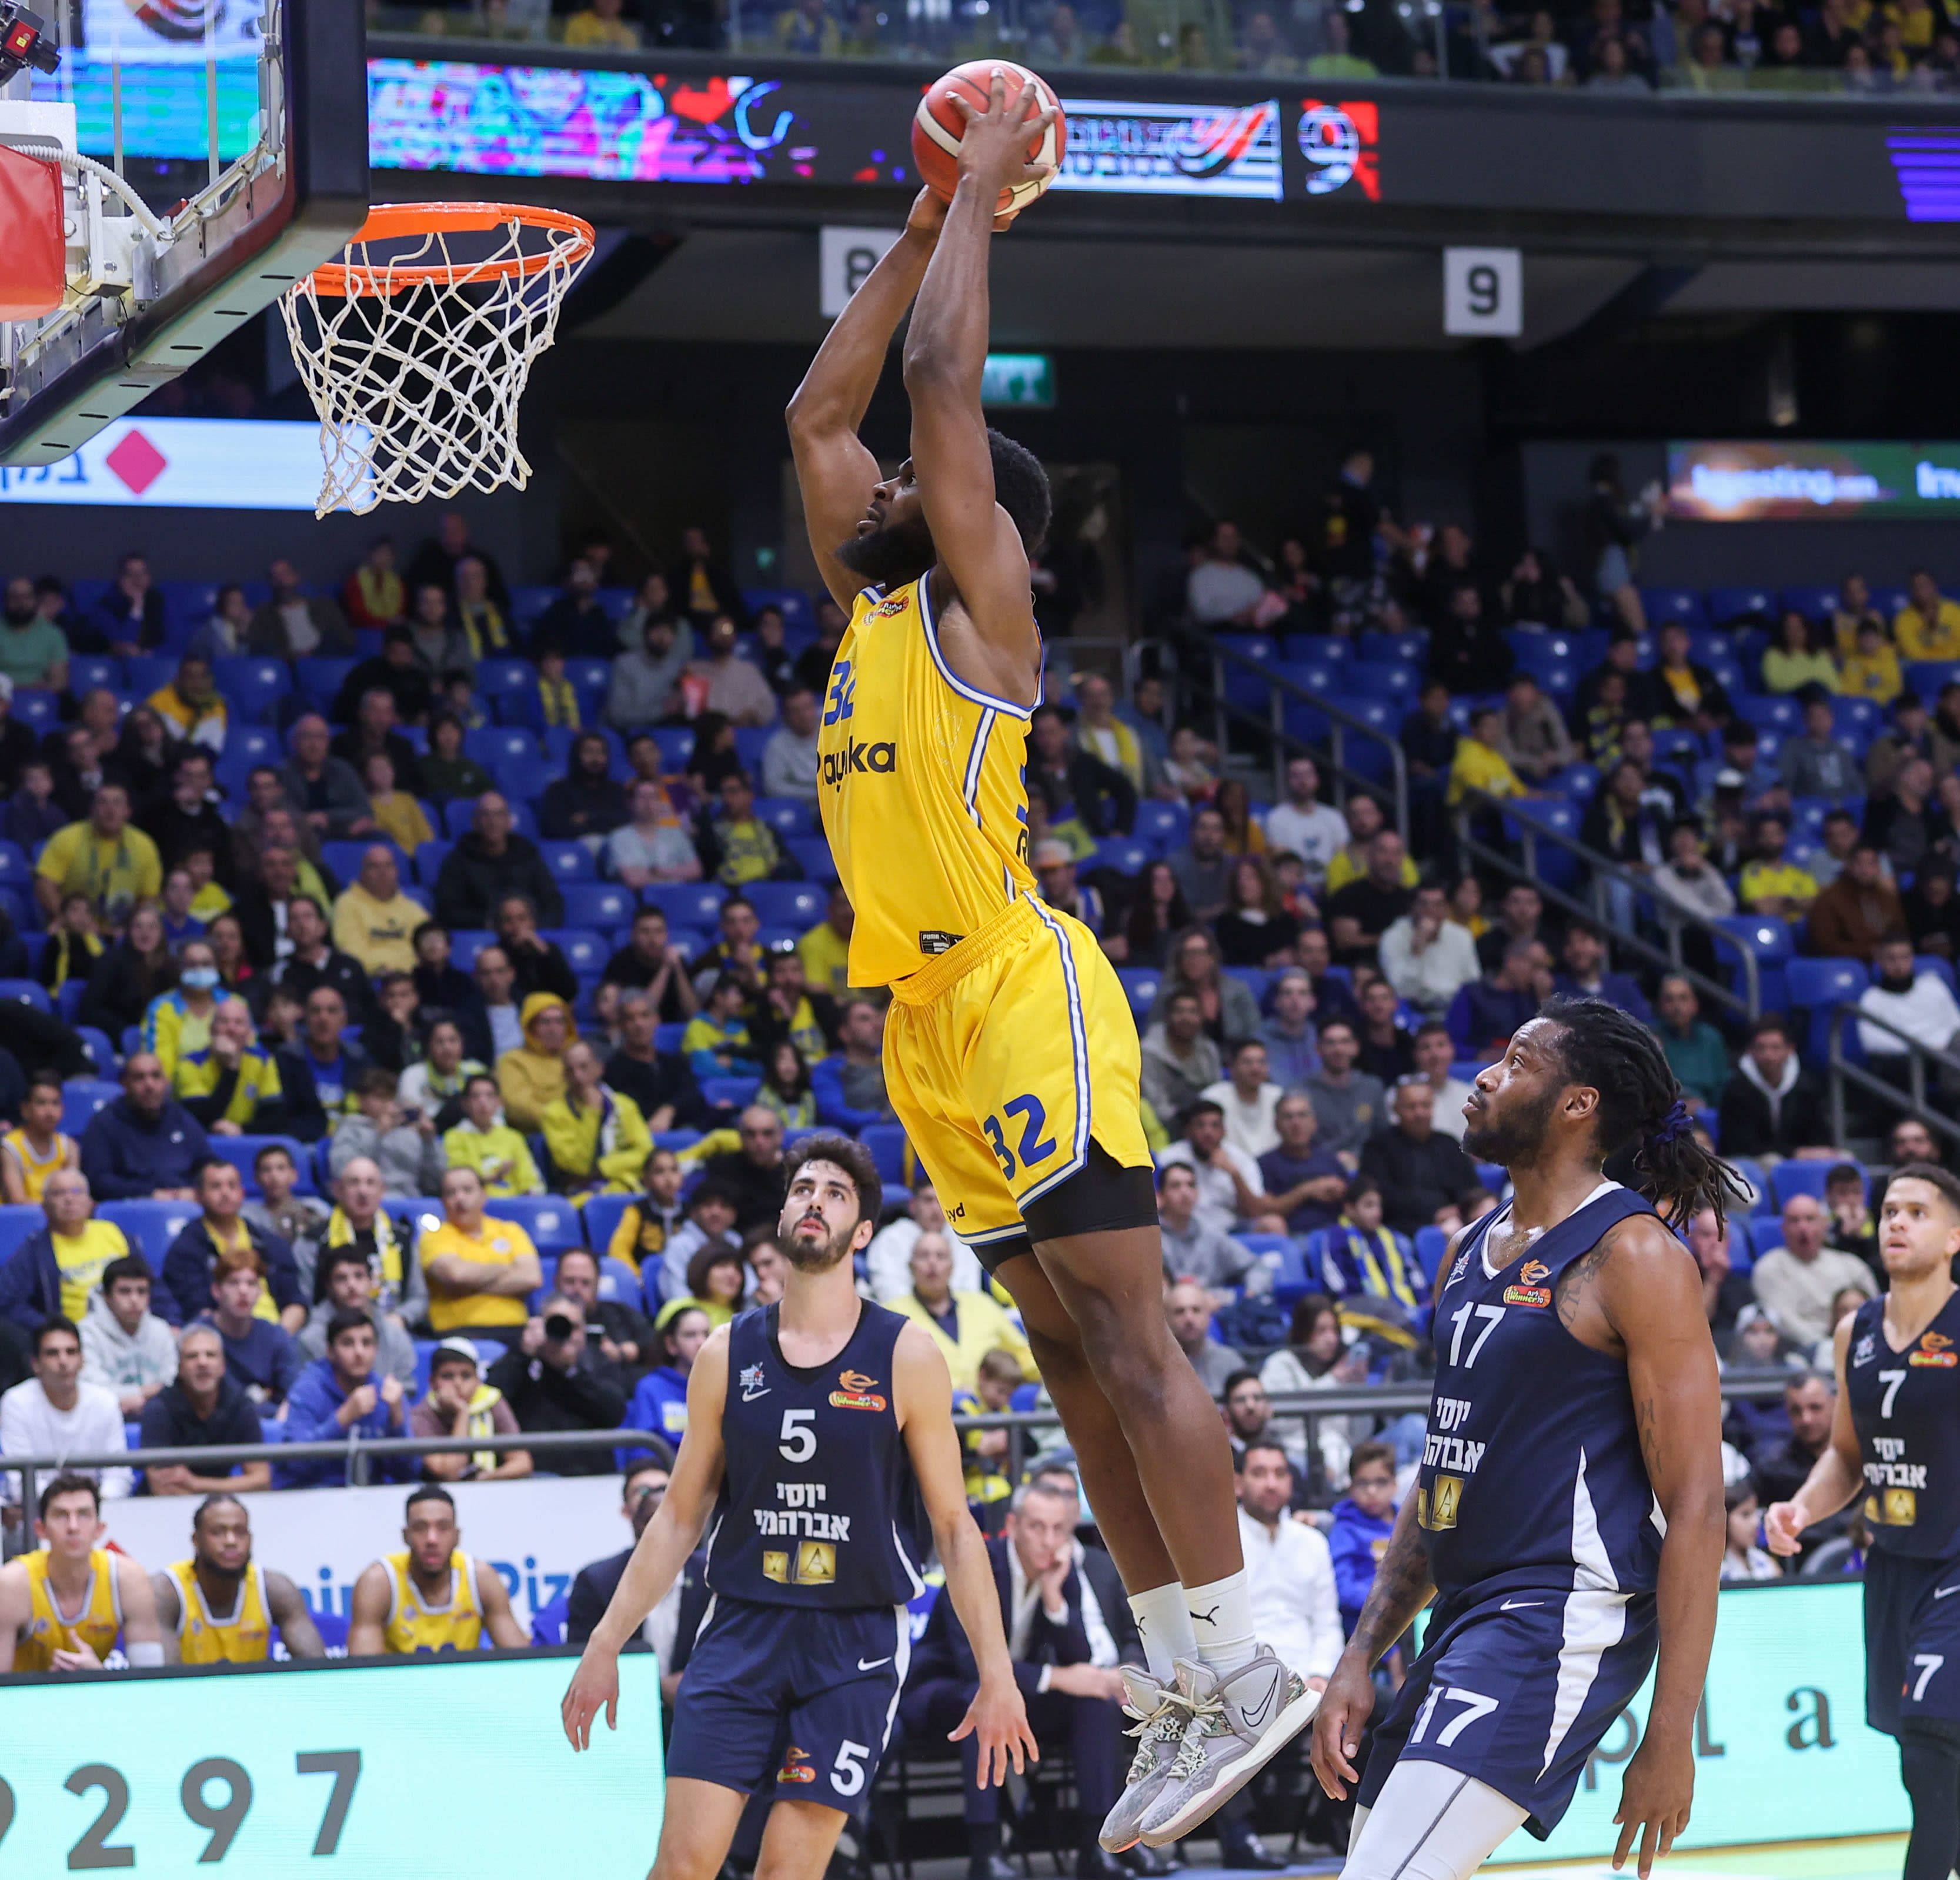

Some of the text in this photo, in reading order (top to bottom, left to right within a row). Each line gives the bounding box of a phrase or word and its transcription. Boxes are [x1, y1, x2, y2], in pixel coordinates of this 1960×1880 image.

[1468, 265, 1499, 316] 9
[984, 1094, 1057, 1180] 32
[946, 1202, 966, 1222] yd
[1510, 1291, 1537, 1303] Winner
[1448, 1301, 1506, 1369] 17
[837, 1395, 872, 1407] Winner
[1436, 1397, 1471, 1431] יוסי
[1878, 1370, 1906, 1418] 7
[779, 1409, 817, 1463] 5
[776, 1482, 826, 1508] יוסי
[1436, 1482, 1452, 1518] A
[753, 1509, 850, 1542] אברהמי
[806, 1547, 830, 1575] A
[1912, 1654, 1945, 1702] 7
[1411, 1687, 1500, 1748] 17
[830, 1739, 870, 1796] 5
[0, 1749, 361, 1870] 297
